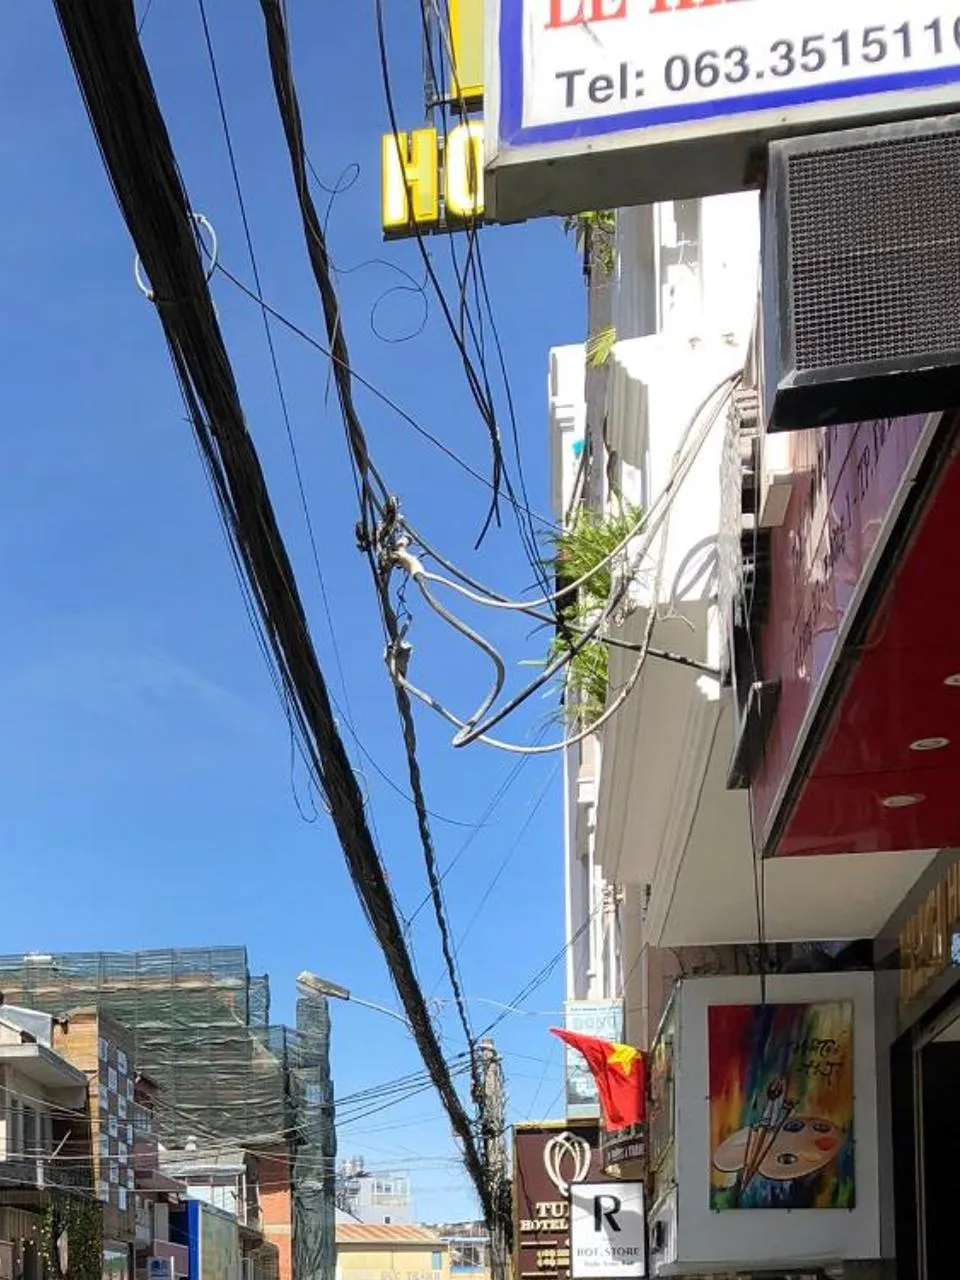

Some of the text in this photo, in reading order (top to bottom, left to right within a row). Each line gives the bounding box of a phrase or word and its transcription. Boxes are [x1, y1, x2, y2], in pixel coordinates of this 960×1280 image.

[555, 16, 960, 108] Tel: 063.351511
[520, 1220, 569, 1231] HOTEL
[594, 1195, 621, 1232] R
